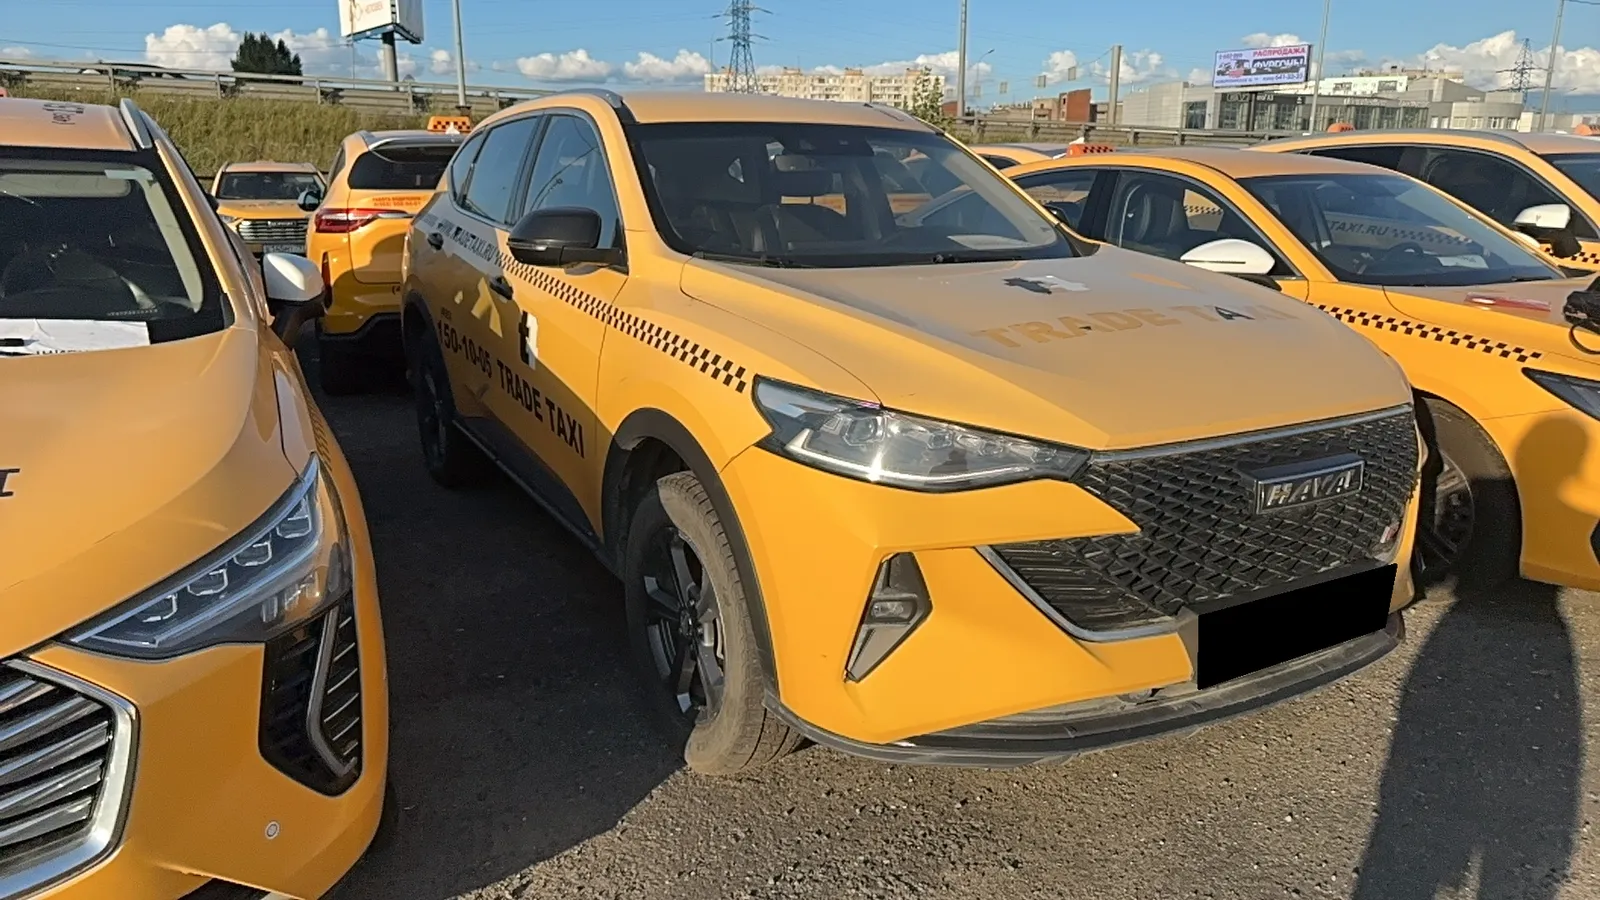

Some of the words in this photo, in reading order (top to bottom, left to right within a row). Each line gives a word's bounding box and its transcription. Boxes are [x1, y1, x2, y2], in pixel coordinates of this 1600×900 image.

[1253, 47, 1305, 57] РАСПРОДАЖА
[1327, 219, 1390, 236] TAXI.RU
[971, 308, 1181, 348] TRADE
[437, 319, 493, 378] 150-10-05
[497, 359, 544, 422] TRADE
[545, 397, 586, 459] TAXI
